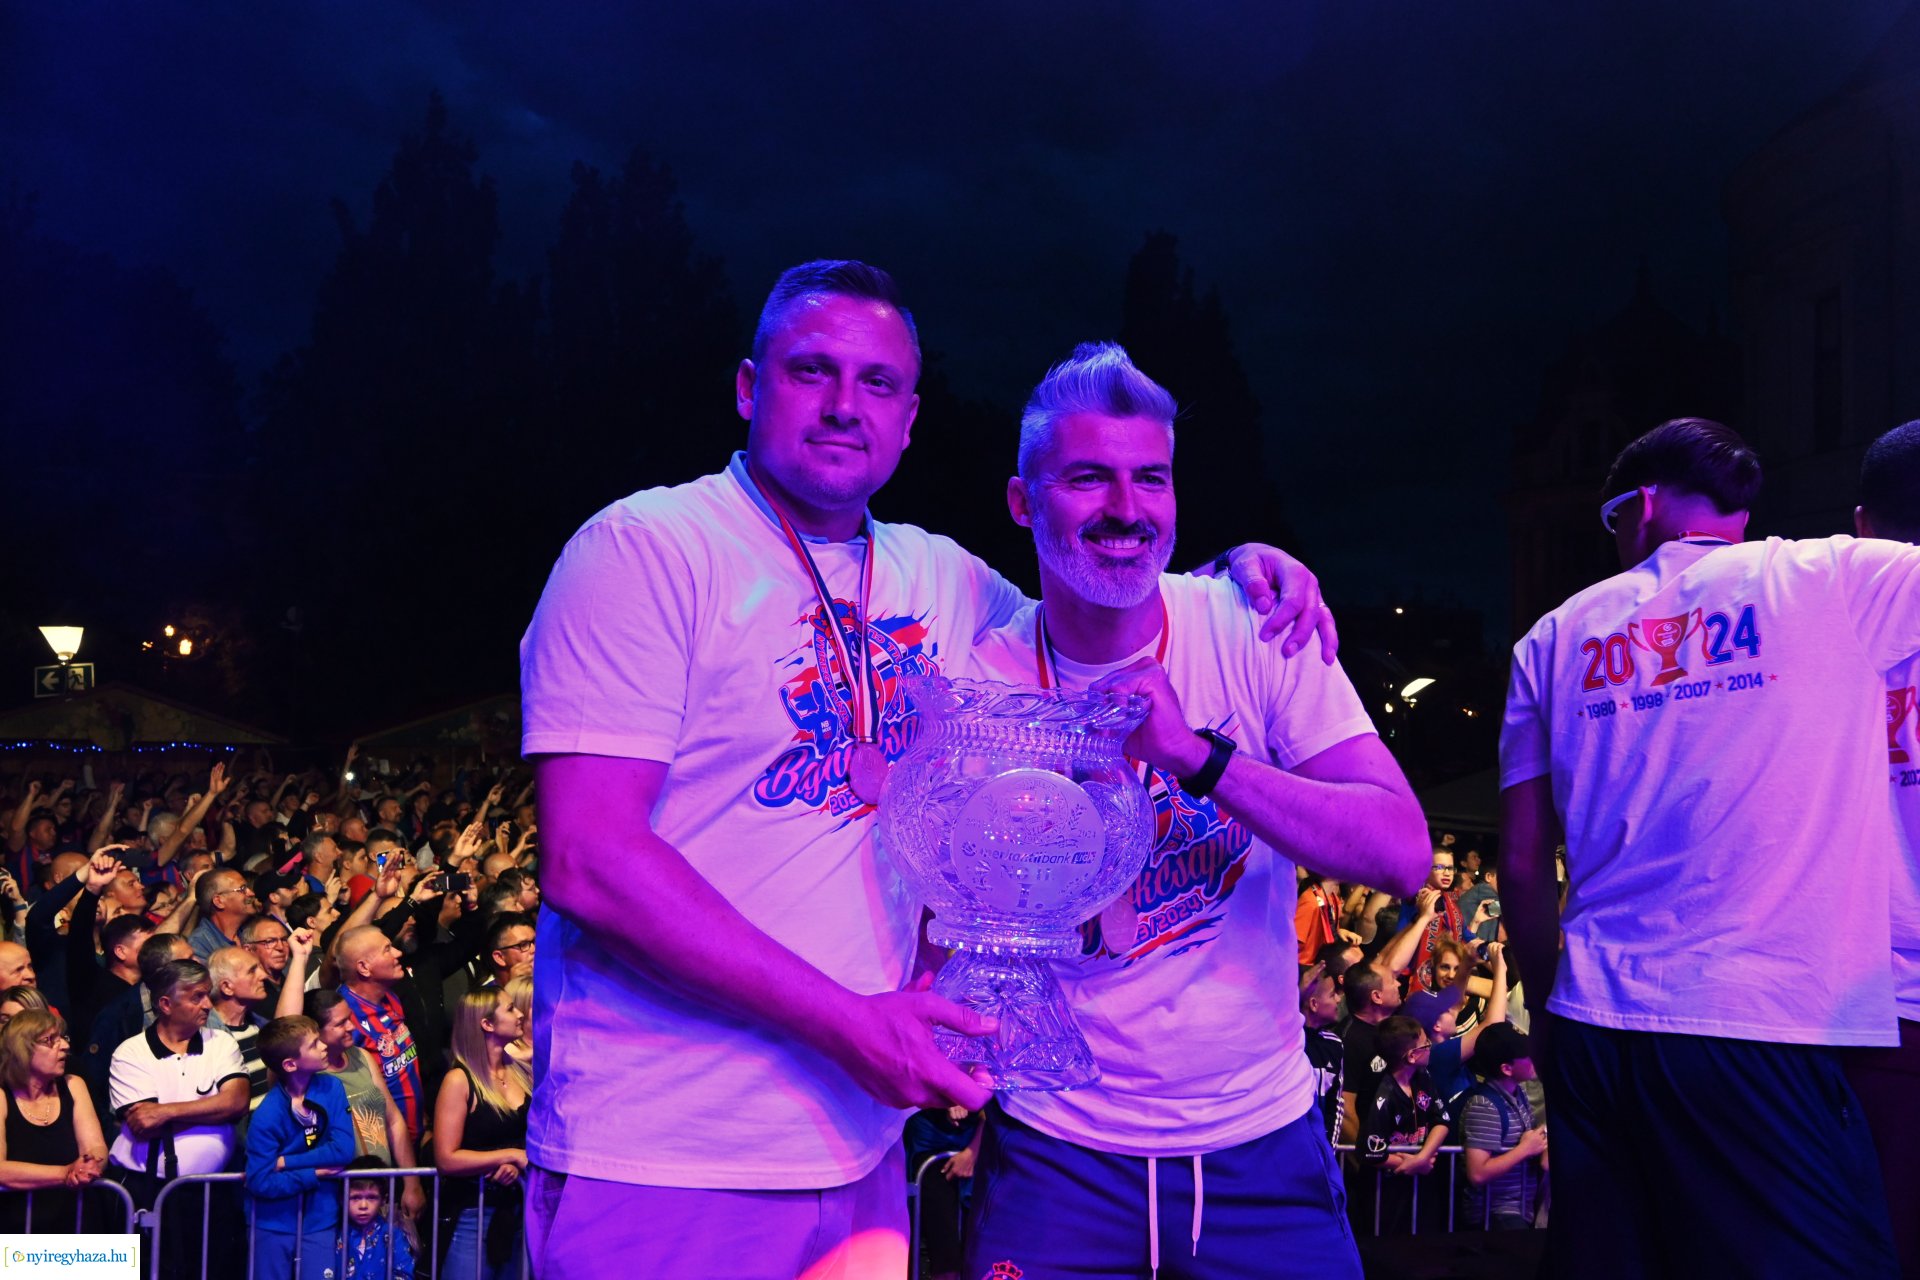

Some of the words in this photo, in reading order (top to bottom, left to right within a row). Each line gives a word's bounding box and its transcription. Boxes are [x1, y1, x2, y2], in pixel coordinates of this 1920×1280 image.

[1581, 632, 1634, 692] 20
[1704, 604, 1761, 666] 24
[1586, 699, 1617, 719] 1980
[1631, 692, 1663, 712] 1998
[1674, 680, 1711, 700] 2007
[1727, 672, 1763, 692] 2014
